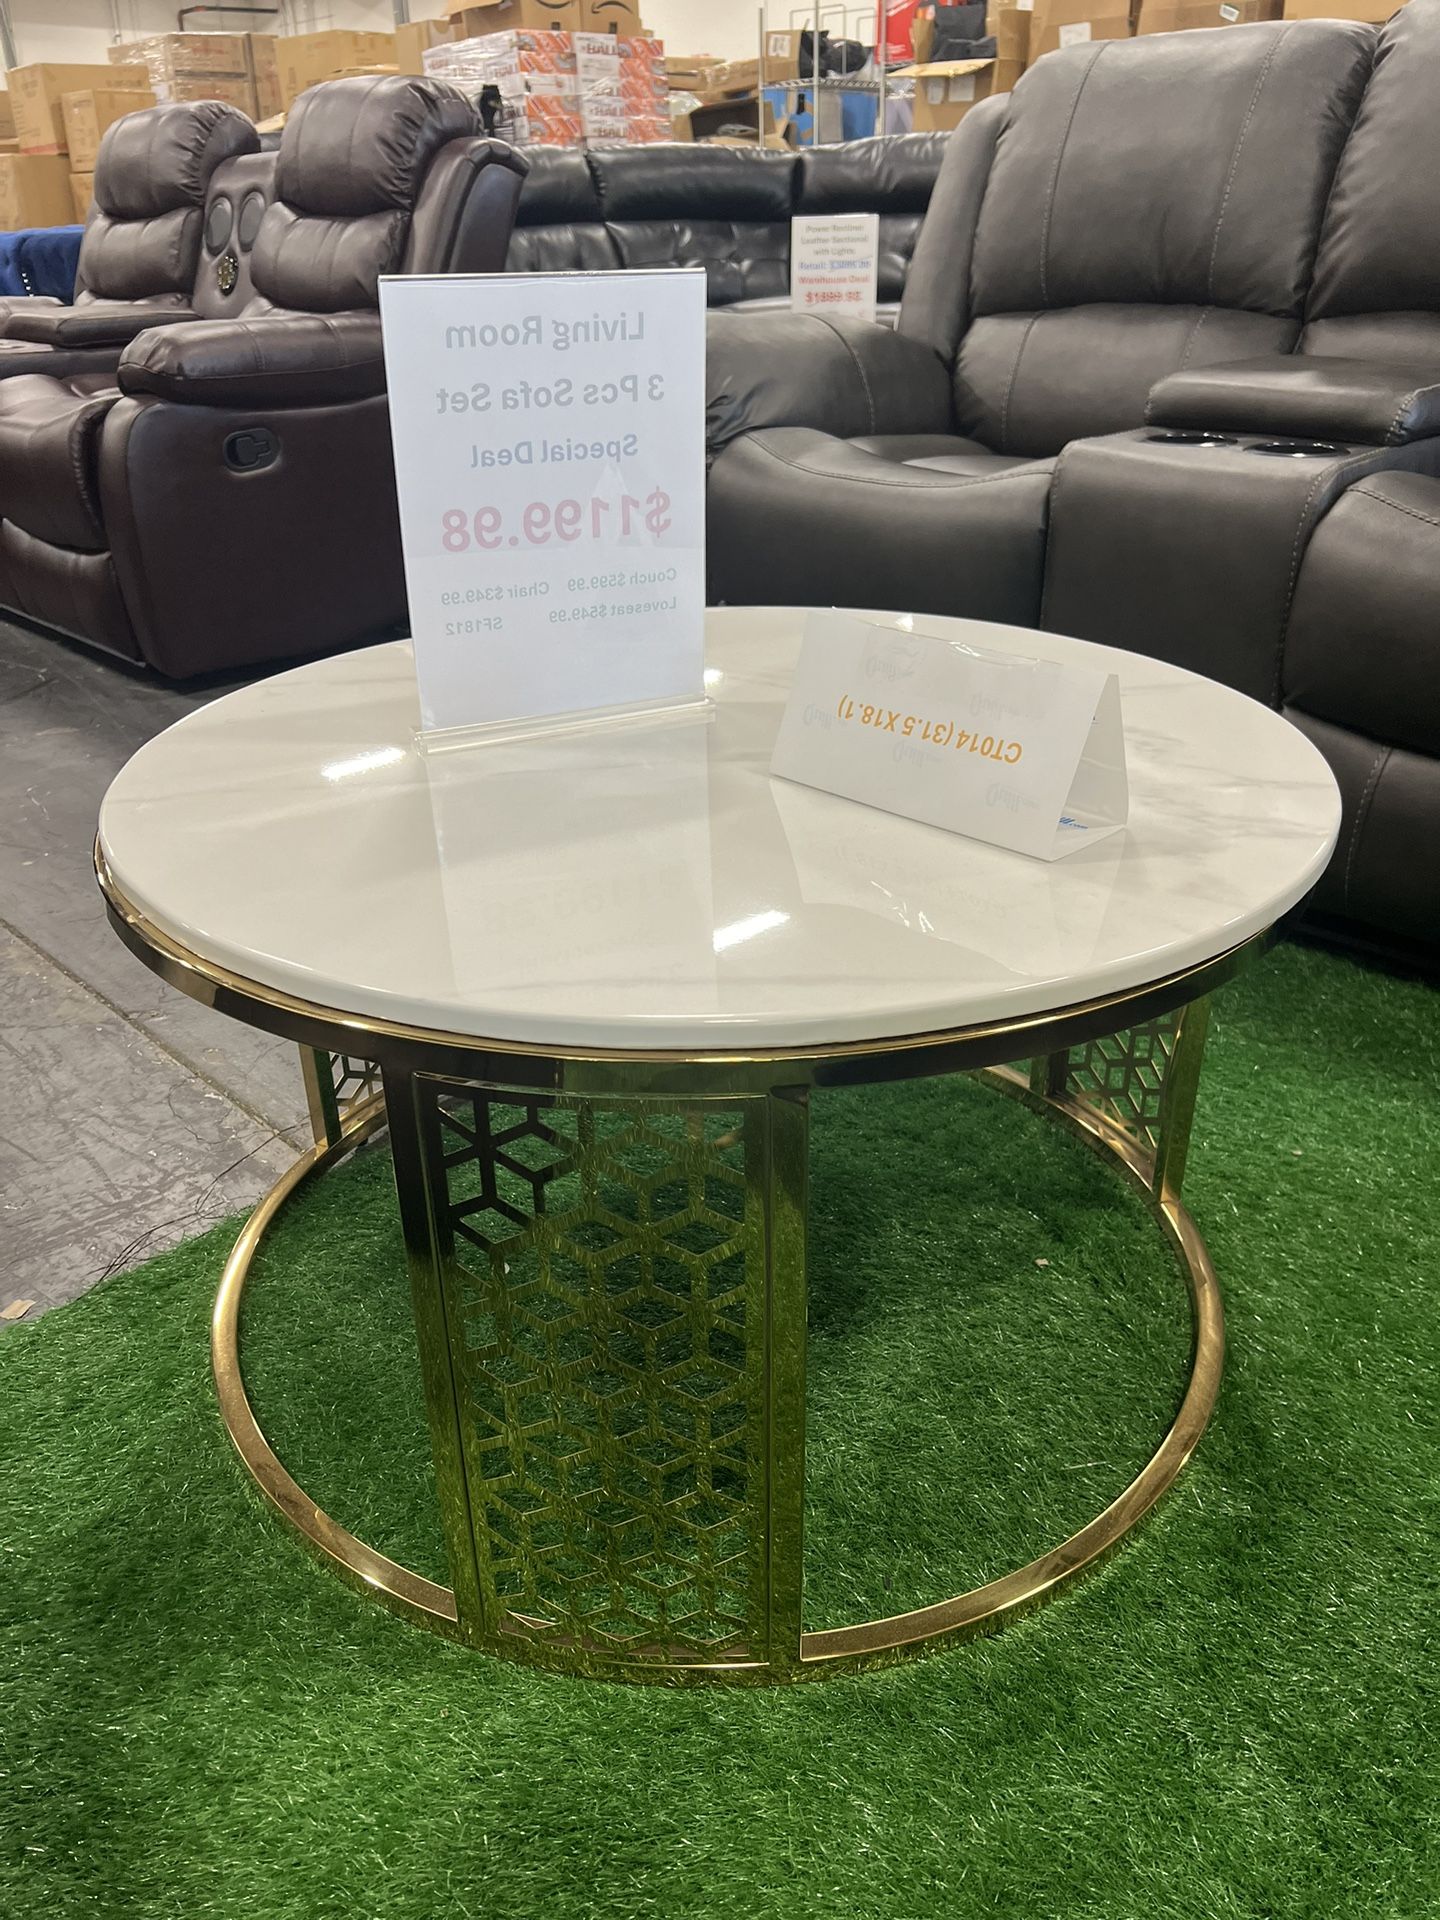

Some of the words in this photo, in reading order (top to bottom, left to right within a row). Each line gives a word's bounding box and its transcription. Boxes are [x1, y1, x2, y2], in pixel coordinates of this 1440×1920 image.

[799, 276, 848, 284] Warehouse
[837, 694, 901, 732] X18.1)
[901, 716, 954, 745] (31.5
[956, 730, 1023, 764] CT014
